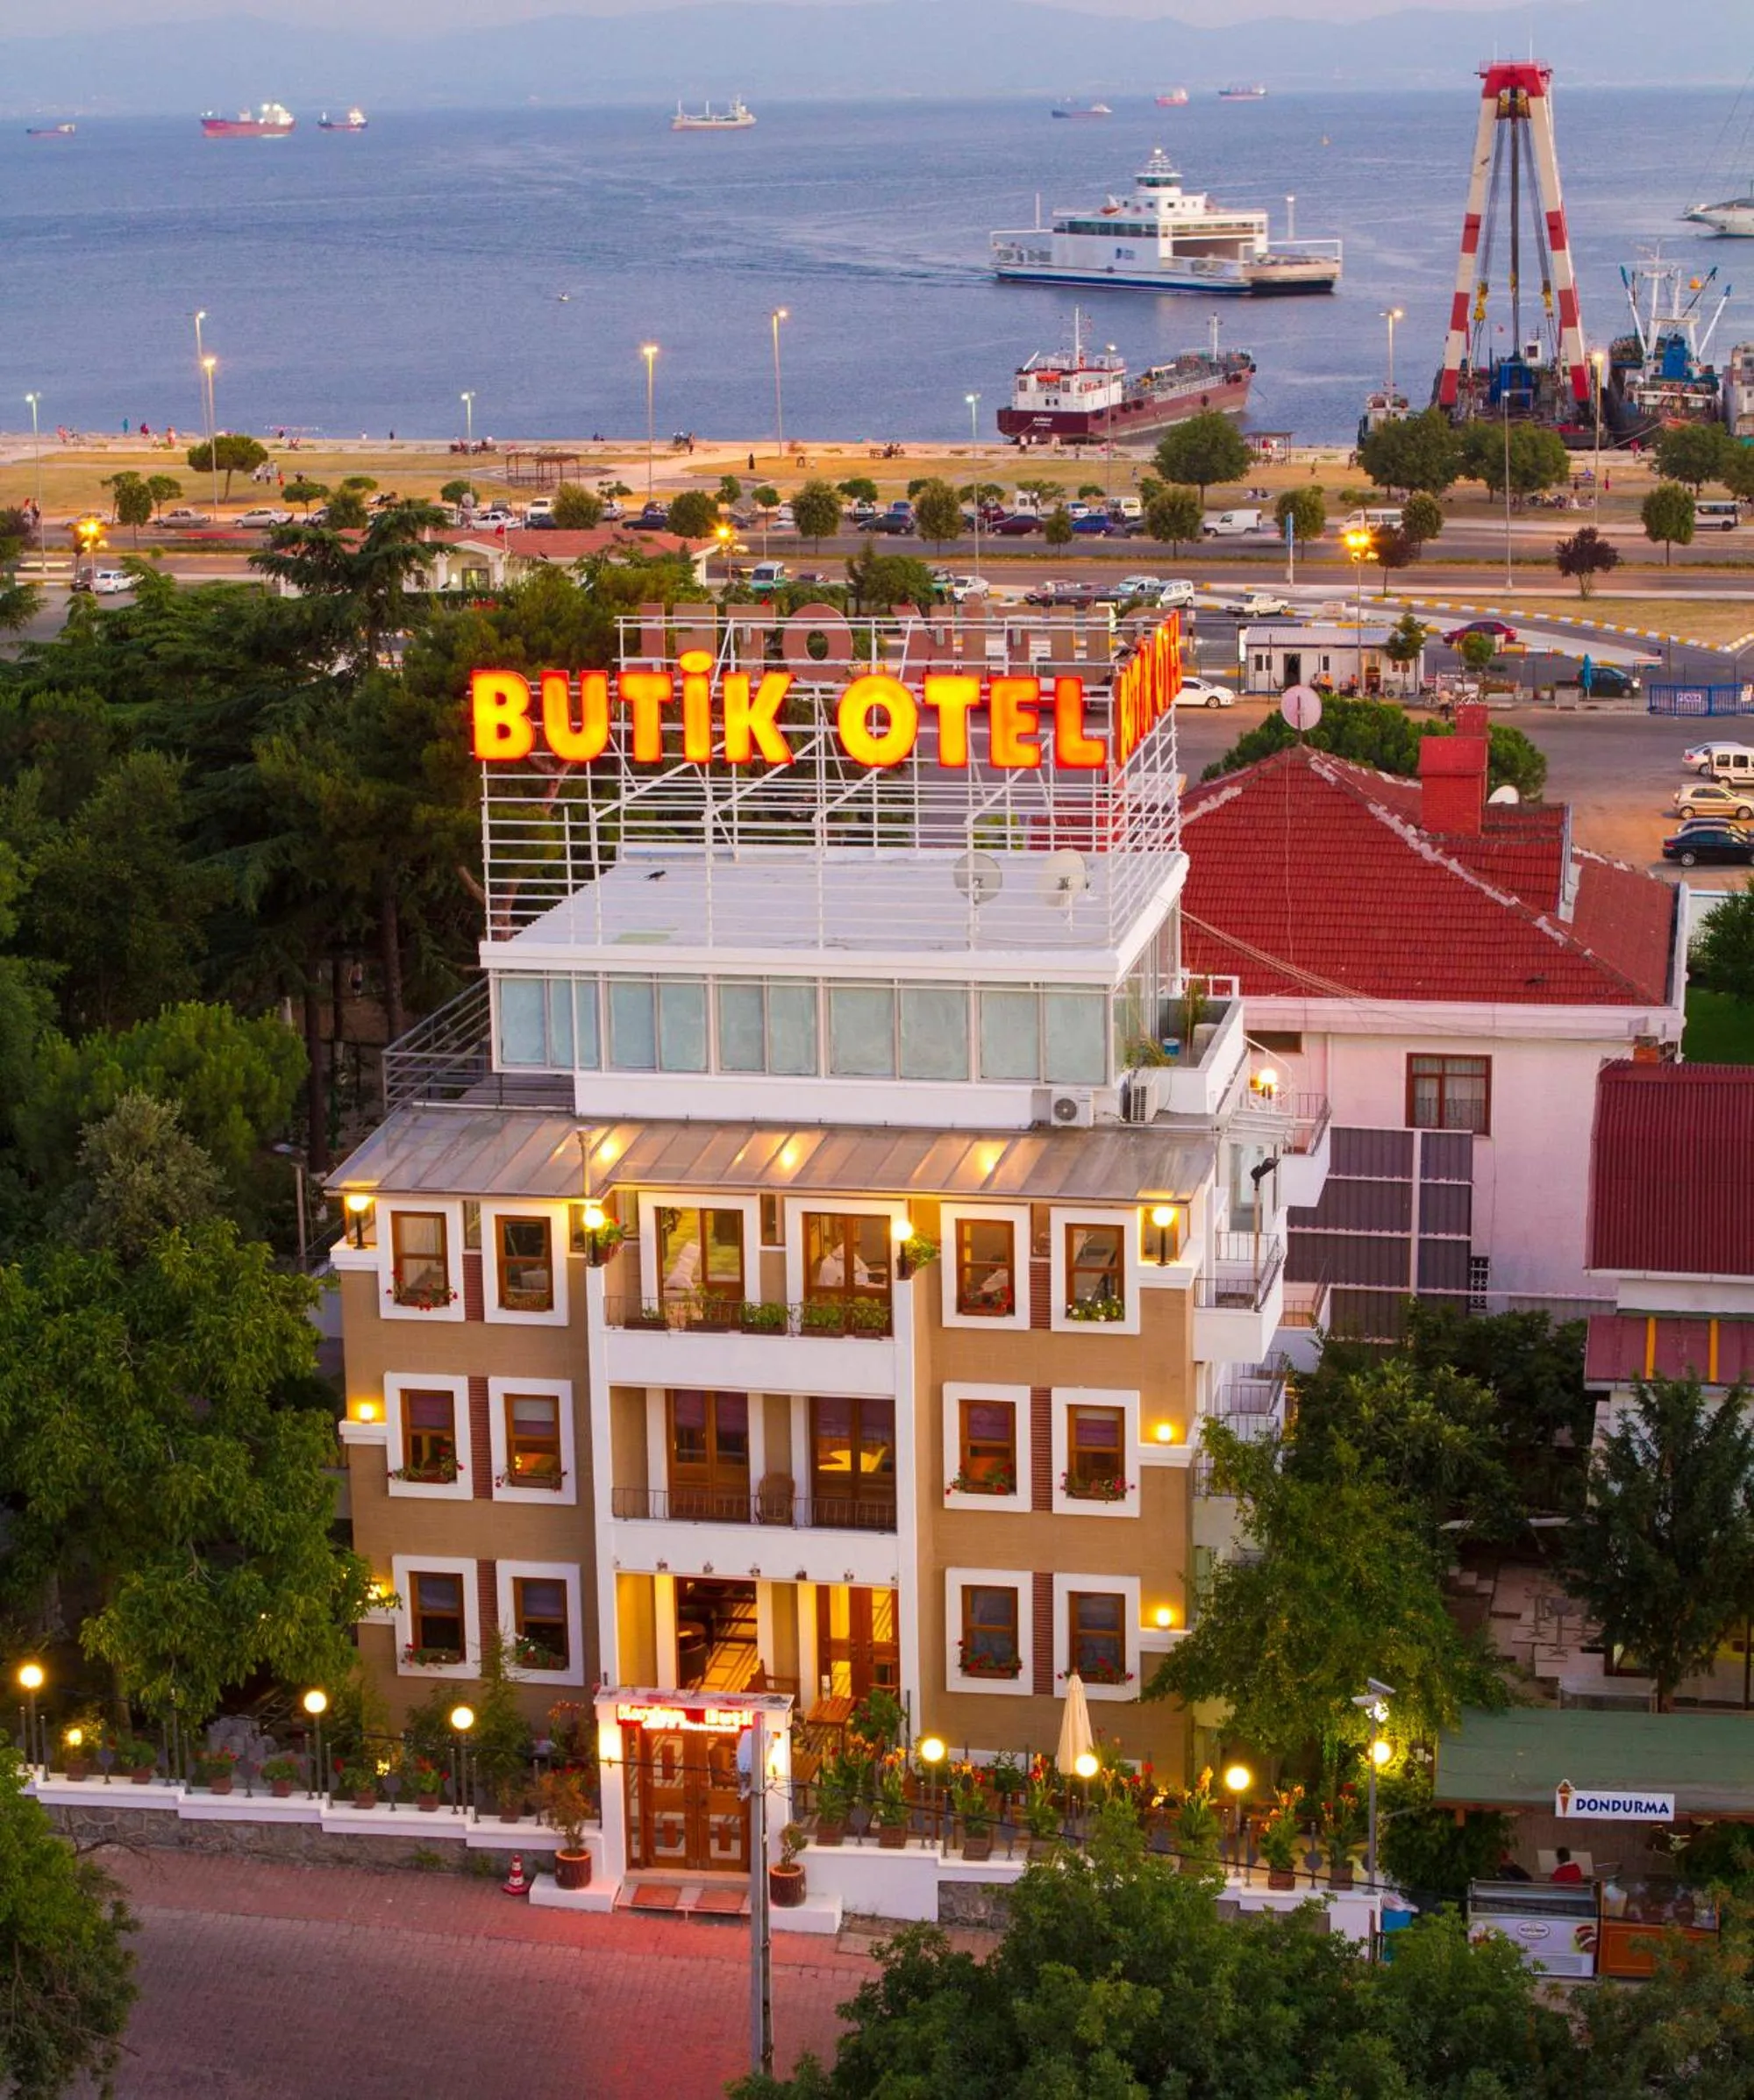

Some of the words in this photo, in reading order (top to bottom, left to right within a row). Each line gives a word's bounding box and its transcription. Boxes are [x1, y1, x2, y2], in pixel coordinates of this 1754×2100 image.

[471, 649, 796, 764] BUTİK
[837, 673, 1107, 769] OTEL
[1575, 1797, 1671, 1815] DONDURMA
